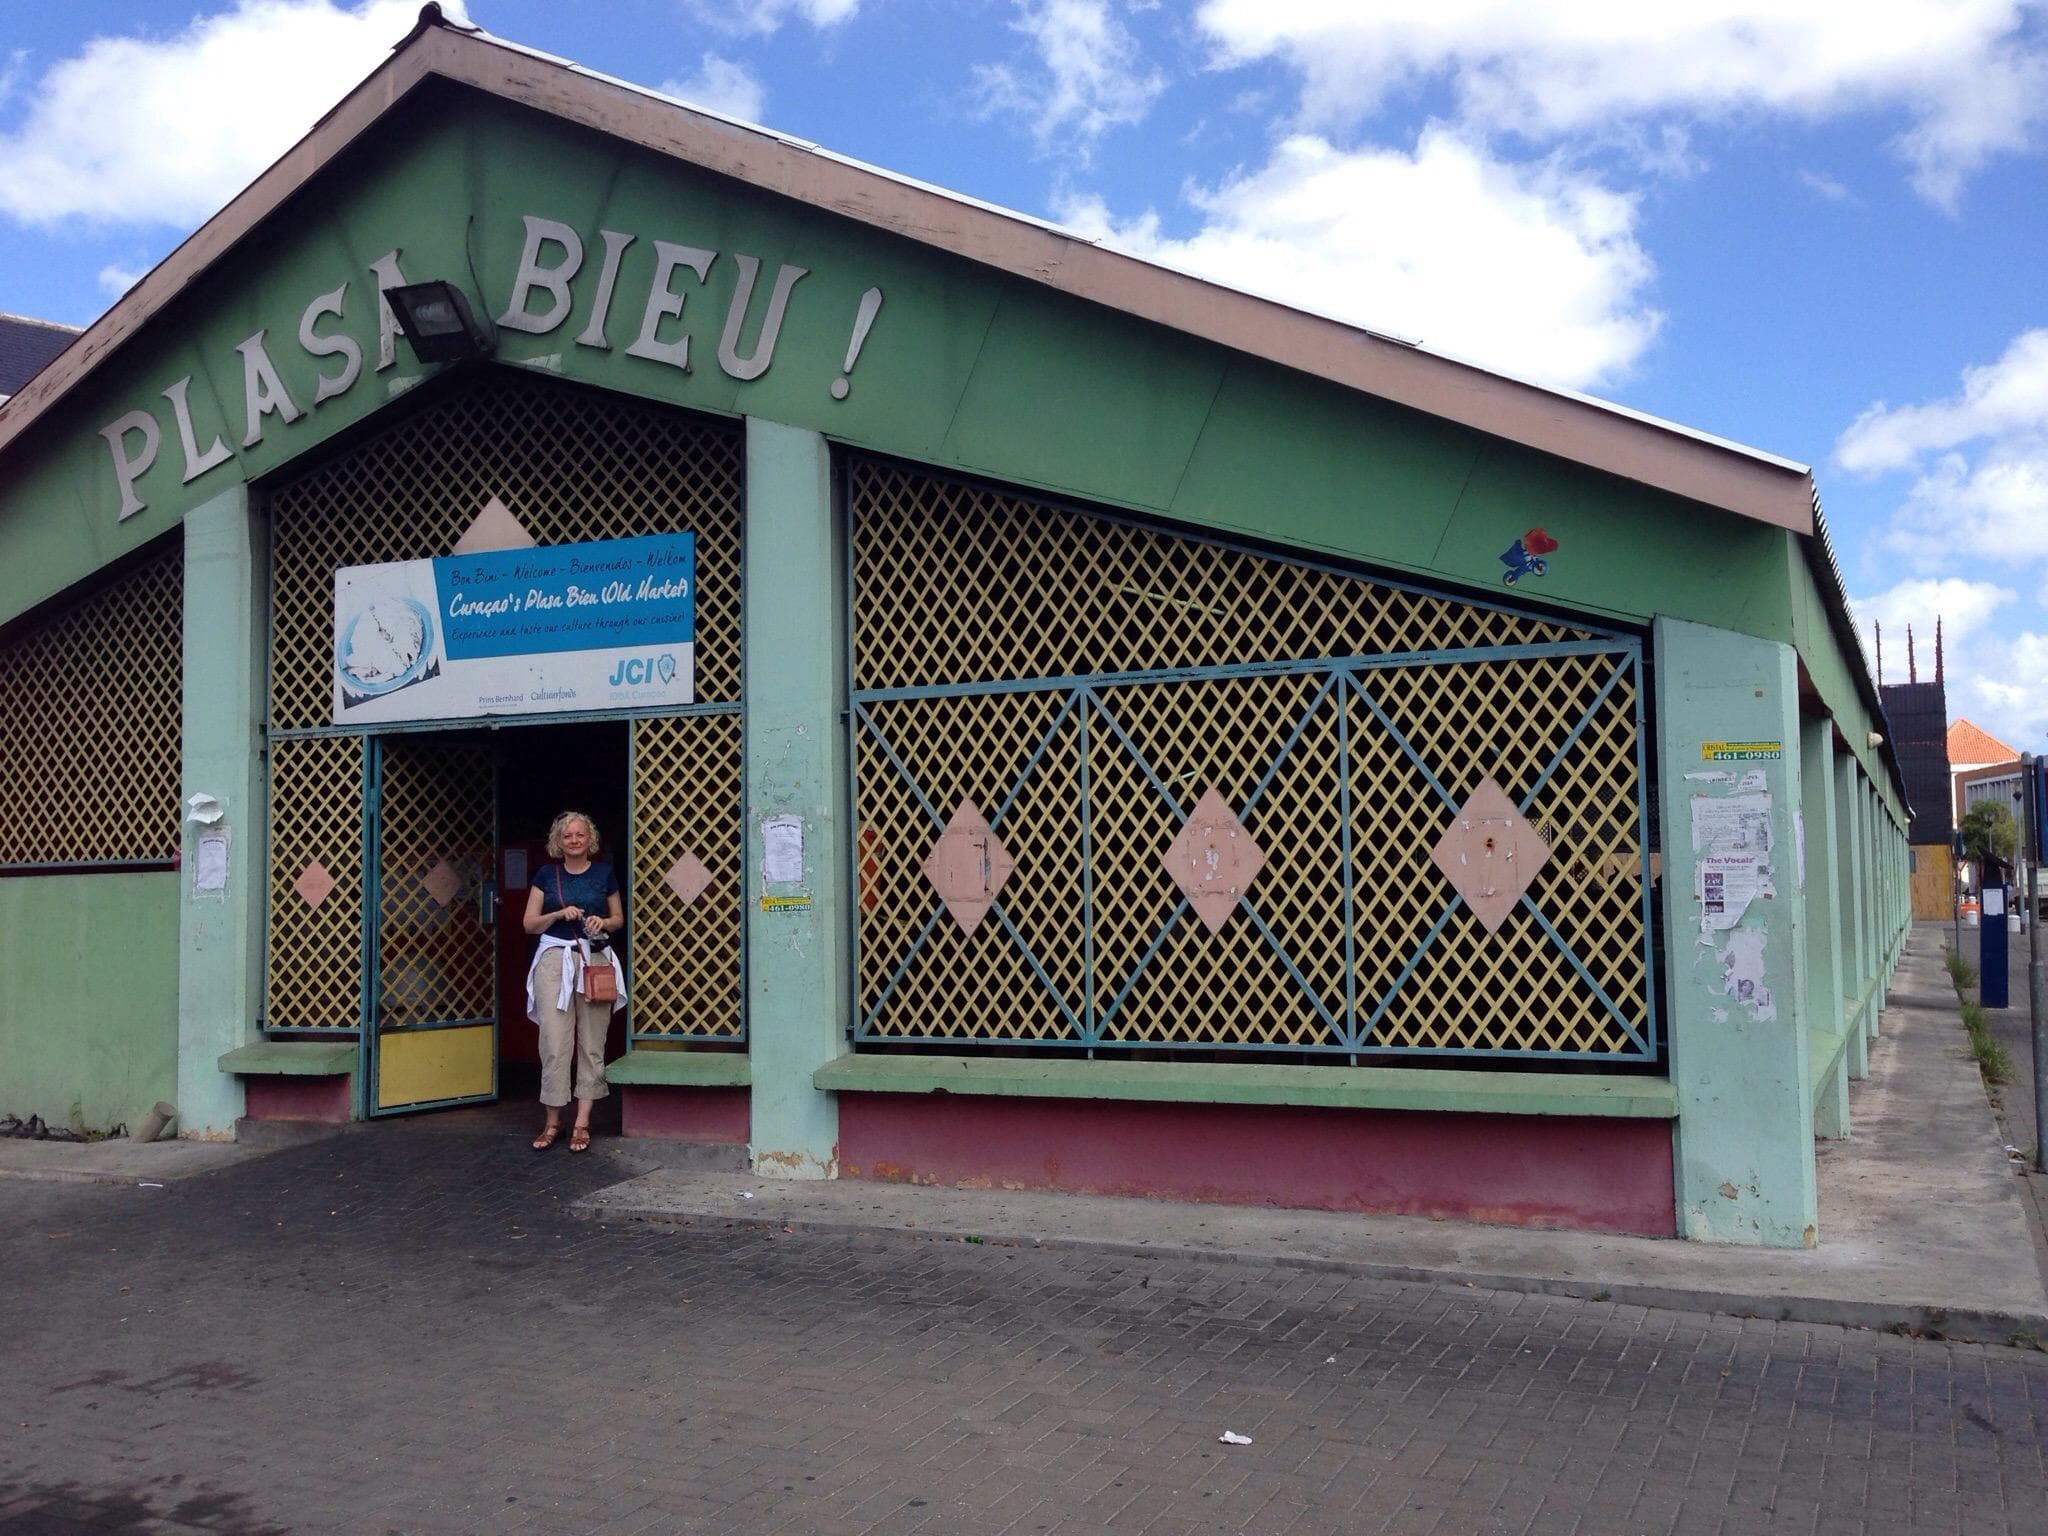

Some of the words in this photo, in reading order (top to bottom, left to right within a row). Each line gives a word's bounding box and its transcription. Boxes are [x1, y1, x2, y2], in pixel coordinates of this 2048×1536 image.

[98, 248, 410, 523] PLASA
[496, 215, 810, 382] BIEU
[450, 570, 470, 586] Bon
[474, 568, 499, 584] Bini
[513, 564, 556, 580] Welcome
[570, 557, 632, 575] Bienvenidos
[646, 549, 686, 567] Welkom
[449, 593, 521, 618] Curaçao's
[524, 588, 563, 611] Plasa
[602, 581, 633, 604] (Old
[636, 574, 688, 601] Market)
[451, 627, 496, 642] Experience
[500, 627, 516, 637] and
[520, 623, 541, 638] taste
[545, 624, 557, 633] our
[561, 619, 592, 633] culture
[596, 615, 630, 634] through
[633, 618, 646, 626] our
[651, 612, 686, 624] cuisine!
[609, 658, 654, 686] JCI
[479, 696, 494, 704] Prins
[495, 693, 524, 703] Bernhard
[530, 686, 577, 702] Cultuurfonds
[1714, 751, 1780, 760] 461-0980
